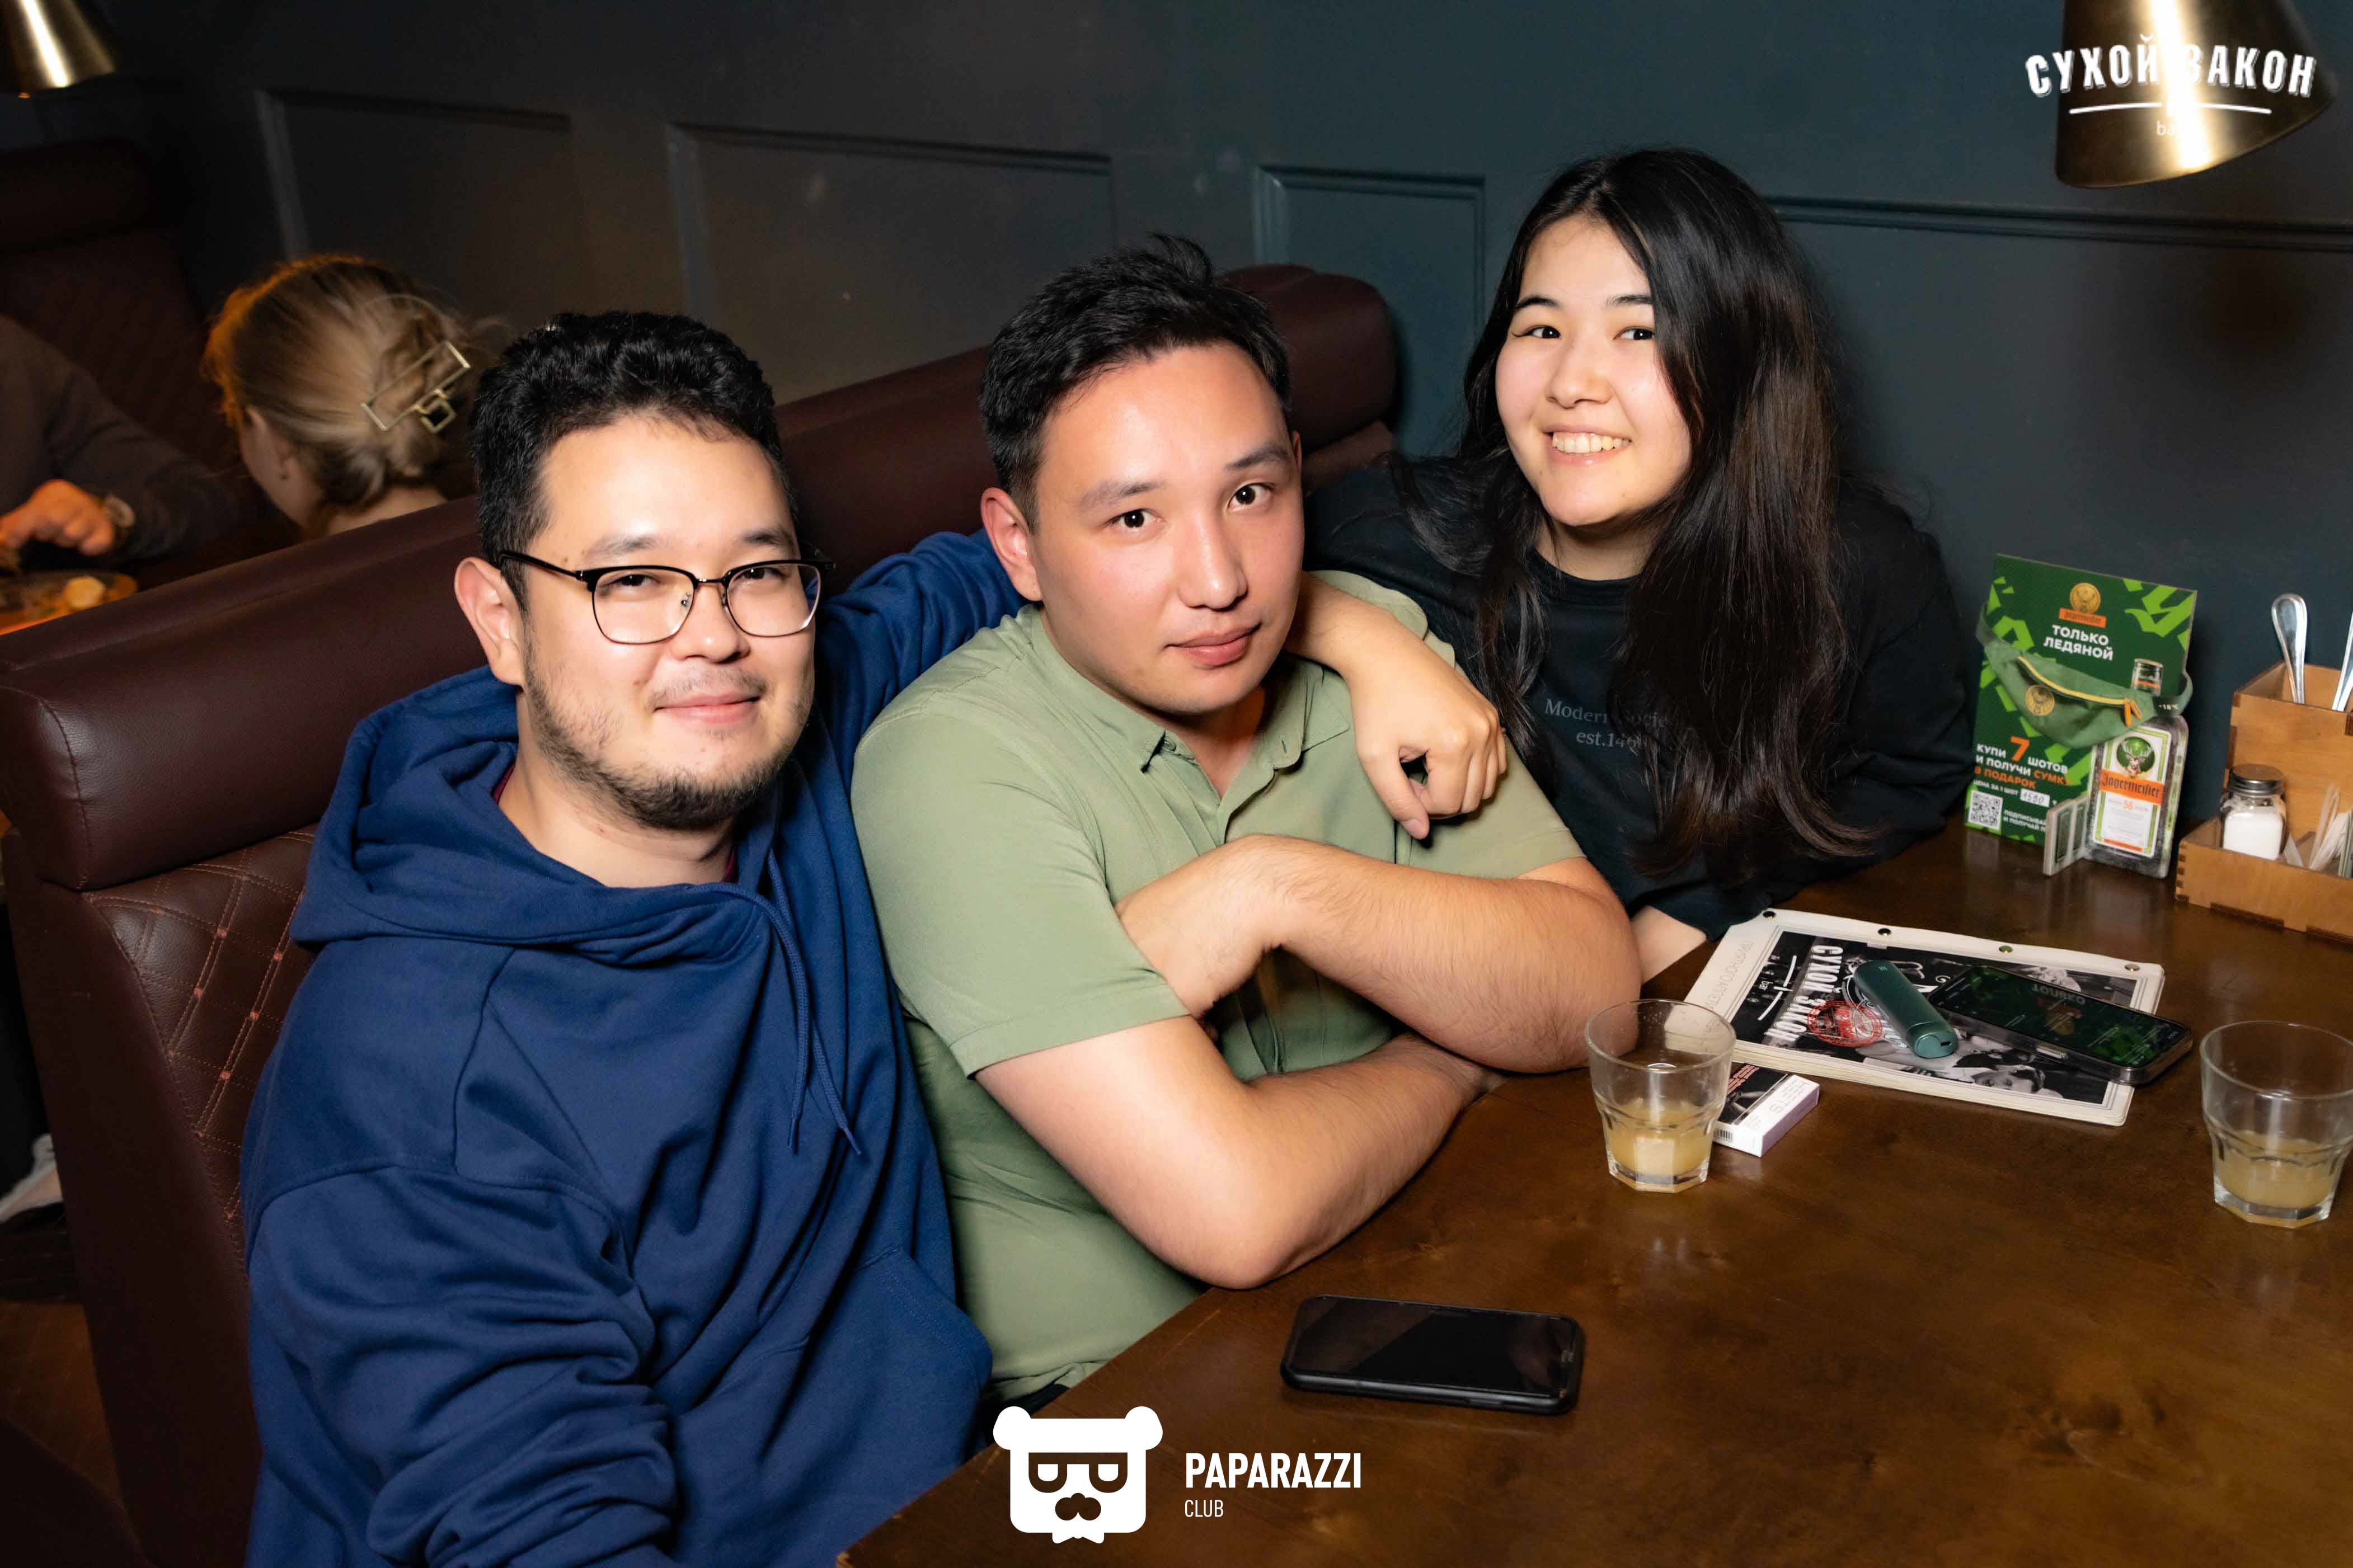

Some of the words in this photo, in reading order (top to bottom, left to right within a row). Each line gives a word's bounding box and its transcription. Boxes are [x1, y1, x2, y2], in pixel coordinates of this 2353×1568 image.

[2051, 624, 2109, 646] ТОЛЬКО
[2044, 637, 2113, 661] ЛЕДЯНОЙ
[1975, 755, 1983, 764] И
[1986, 757, 2031, 776] ПОЛУЧИ
[1976, 743, 2007, 759] КУПИ
[2010, 736, 2030, 761] 7
[2027, 756, 2068, 774] ШОТОВ
[1984, 768, 2037, 789] ПОДАРОК
[1800, 944, 1844, 993] СУХОЙ
[1758, 979, 1774, 991] bar
[1763, 996, 1828, 1042] ЗАКОН
